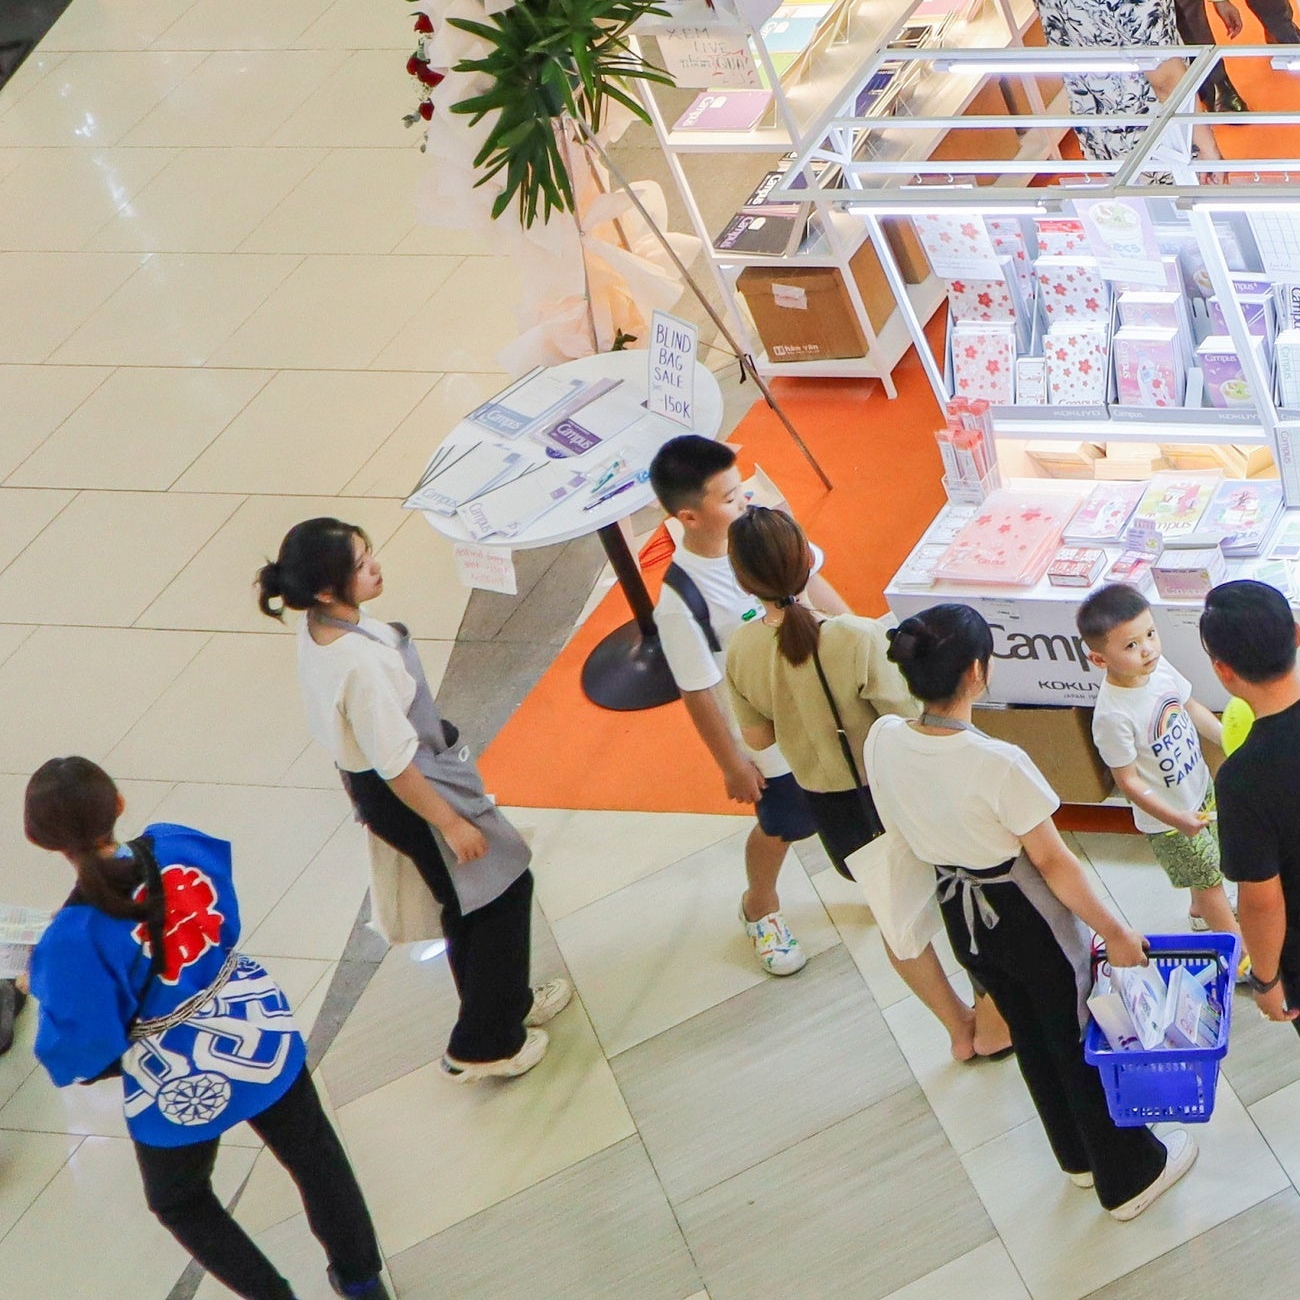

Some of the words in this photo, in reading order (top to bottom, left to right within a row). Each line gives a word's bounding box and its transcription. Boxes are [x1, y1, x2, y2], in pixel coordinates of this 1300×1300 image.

[752, 173, 782, 205] Campus
[720, 215, 754, 248] Campus
[656, 324, 691, 354] BLIND
[659, 348, 683, 371] BAG
[654, 367, 684, 388] SALE
[487, 406, 524, 430] Campus
[556, 422, 594, 449] Campus
[421, 487, 457, 512] Campus
[469, 503, 493, 536] Campus
[1160, 746, 1182, 773] OF
